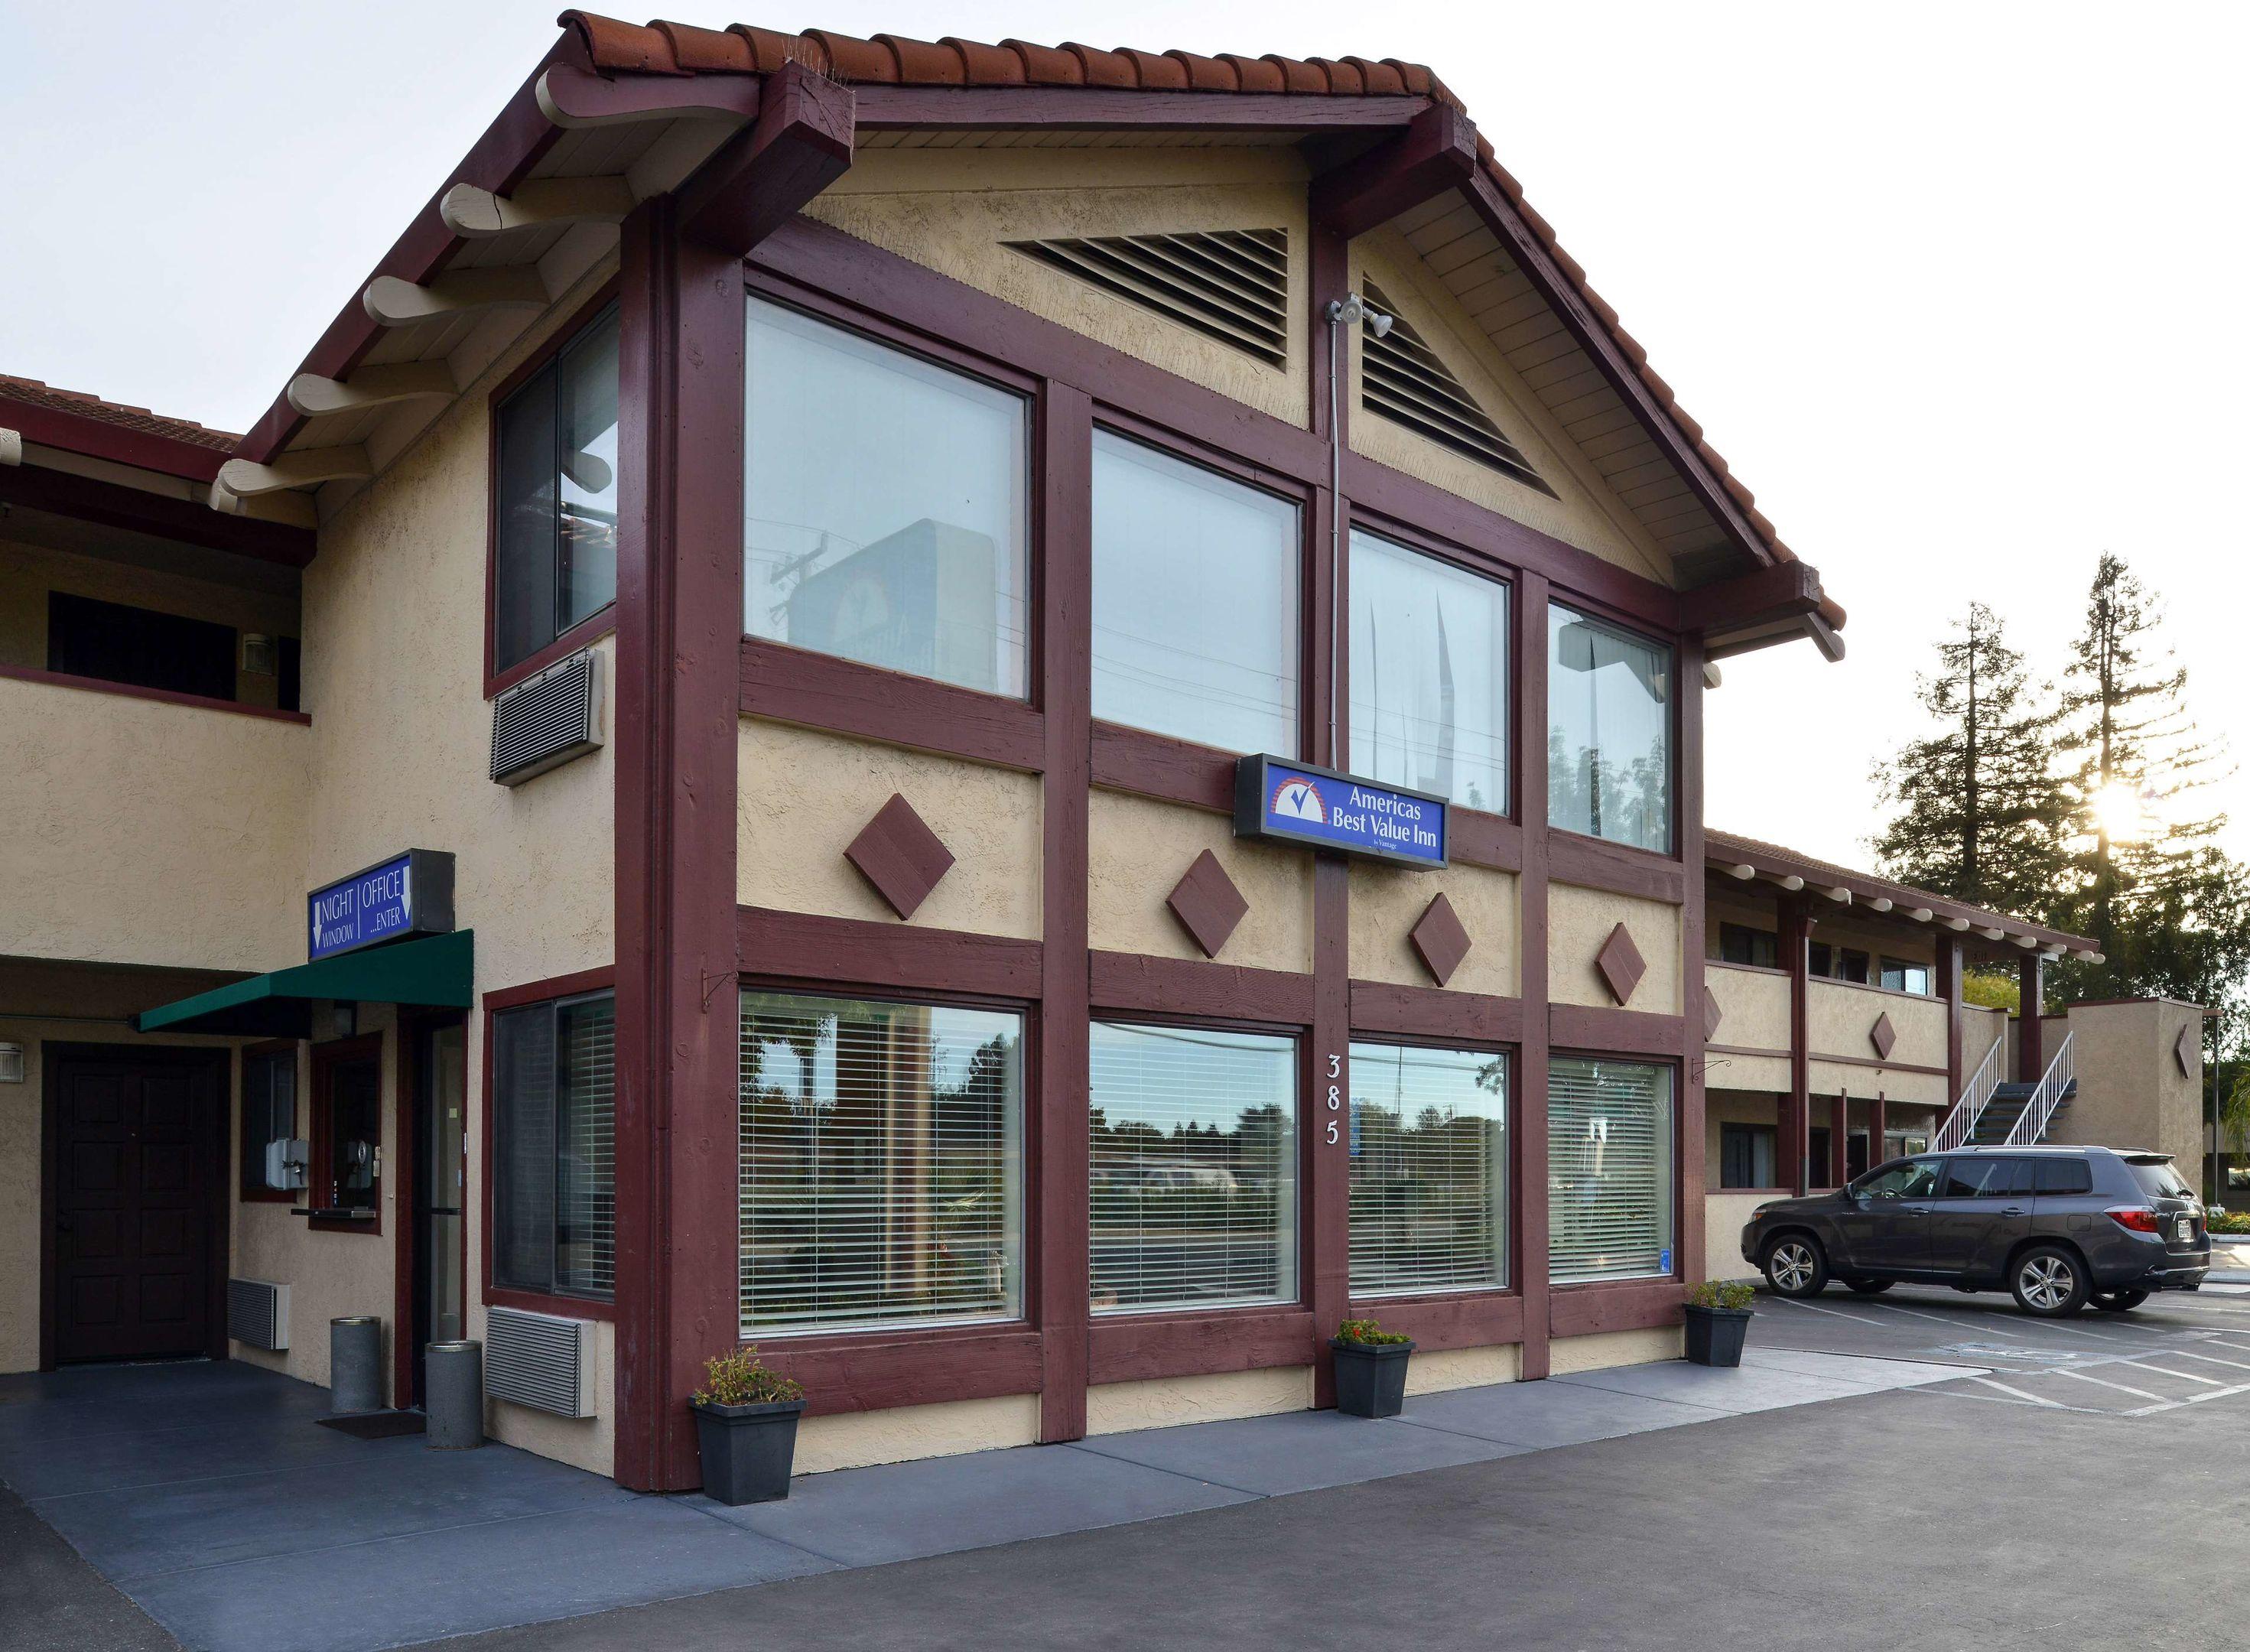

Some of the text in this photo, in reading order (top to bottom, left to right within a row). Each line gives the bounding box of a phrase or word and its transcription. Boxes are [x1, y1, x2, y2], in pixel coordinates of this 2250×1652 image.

[1349, 785, 1421, 821] Americas
[1333, 806, 1437, 847] Best Value Inn
[321, 889, 354, 923] NIGHT
[363, 870, 400, 908] OFFICE
[321, 923, 354, 948] WINDOW
